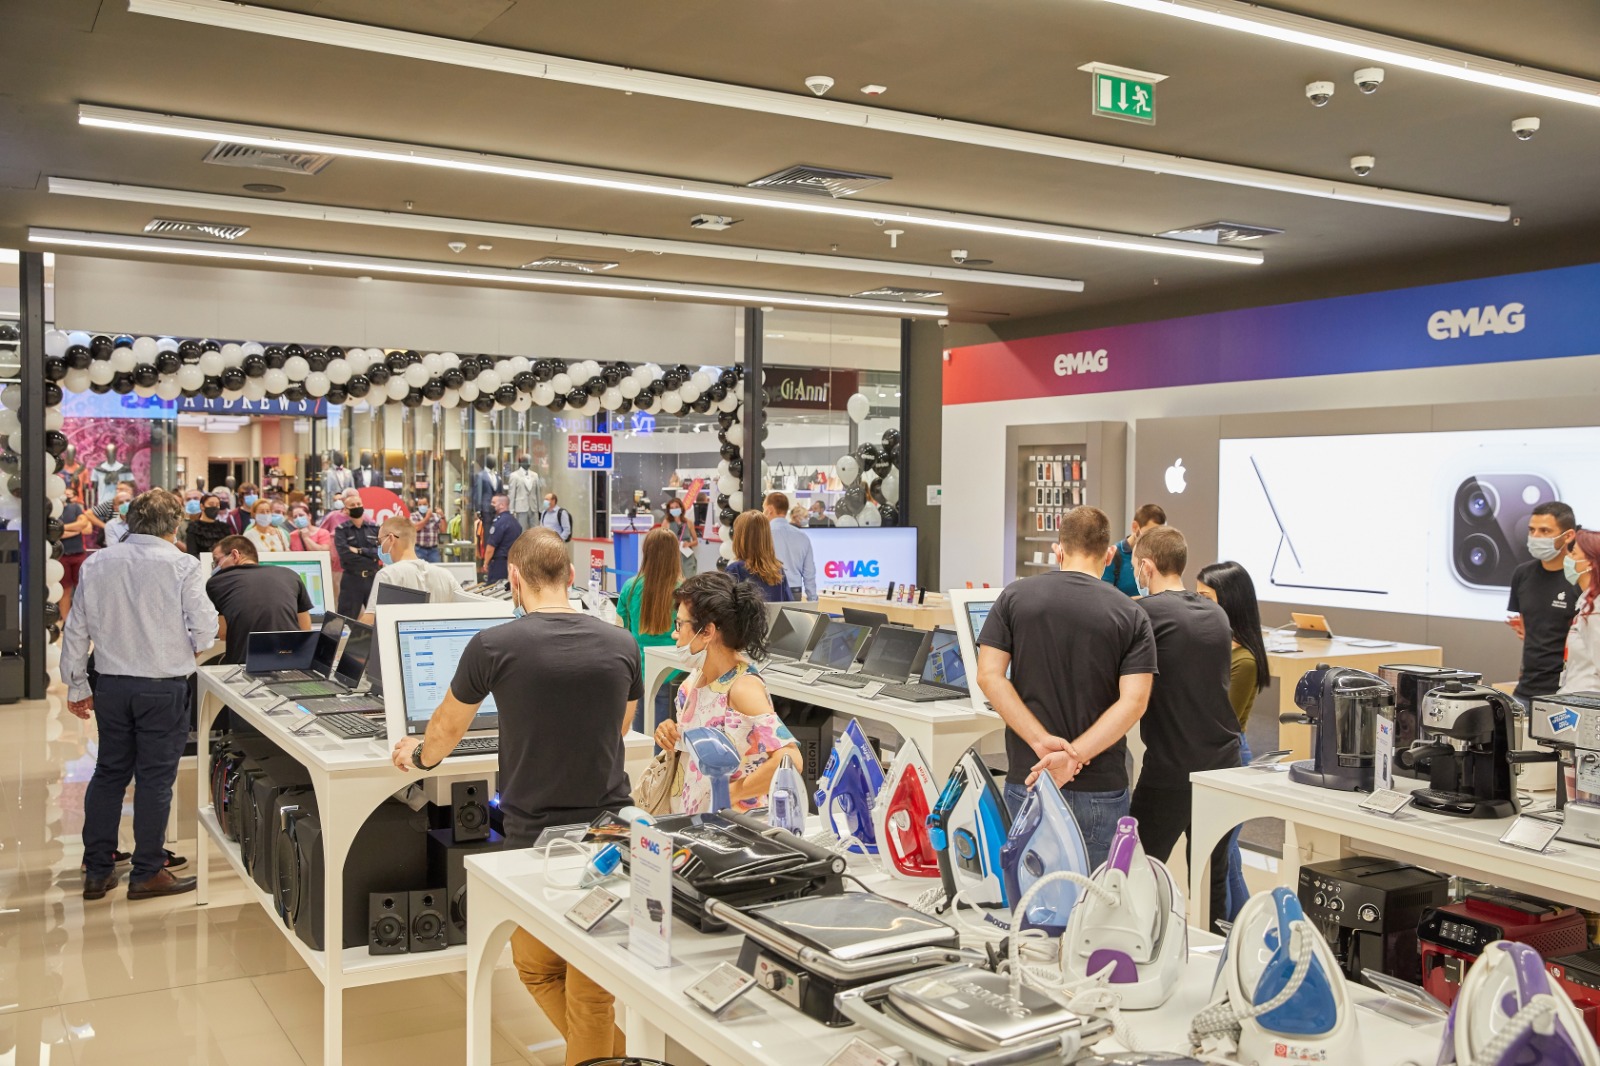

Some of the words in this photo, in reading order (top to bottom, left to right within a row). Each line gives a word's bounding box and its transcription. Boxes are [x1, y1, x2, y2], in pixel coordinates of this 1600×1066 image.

[1427, 302, 1525, 340] eMAG
[1053, 348, 1108, 377] eMAG
[582, 440, 611, 454] Easy
[582, 452, 605, 467] Pay
[824, 559, 880, 578] eMAG
[808, 741, 817, 781] LEGION
[640, 836, 660, 856] eMAG
